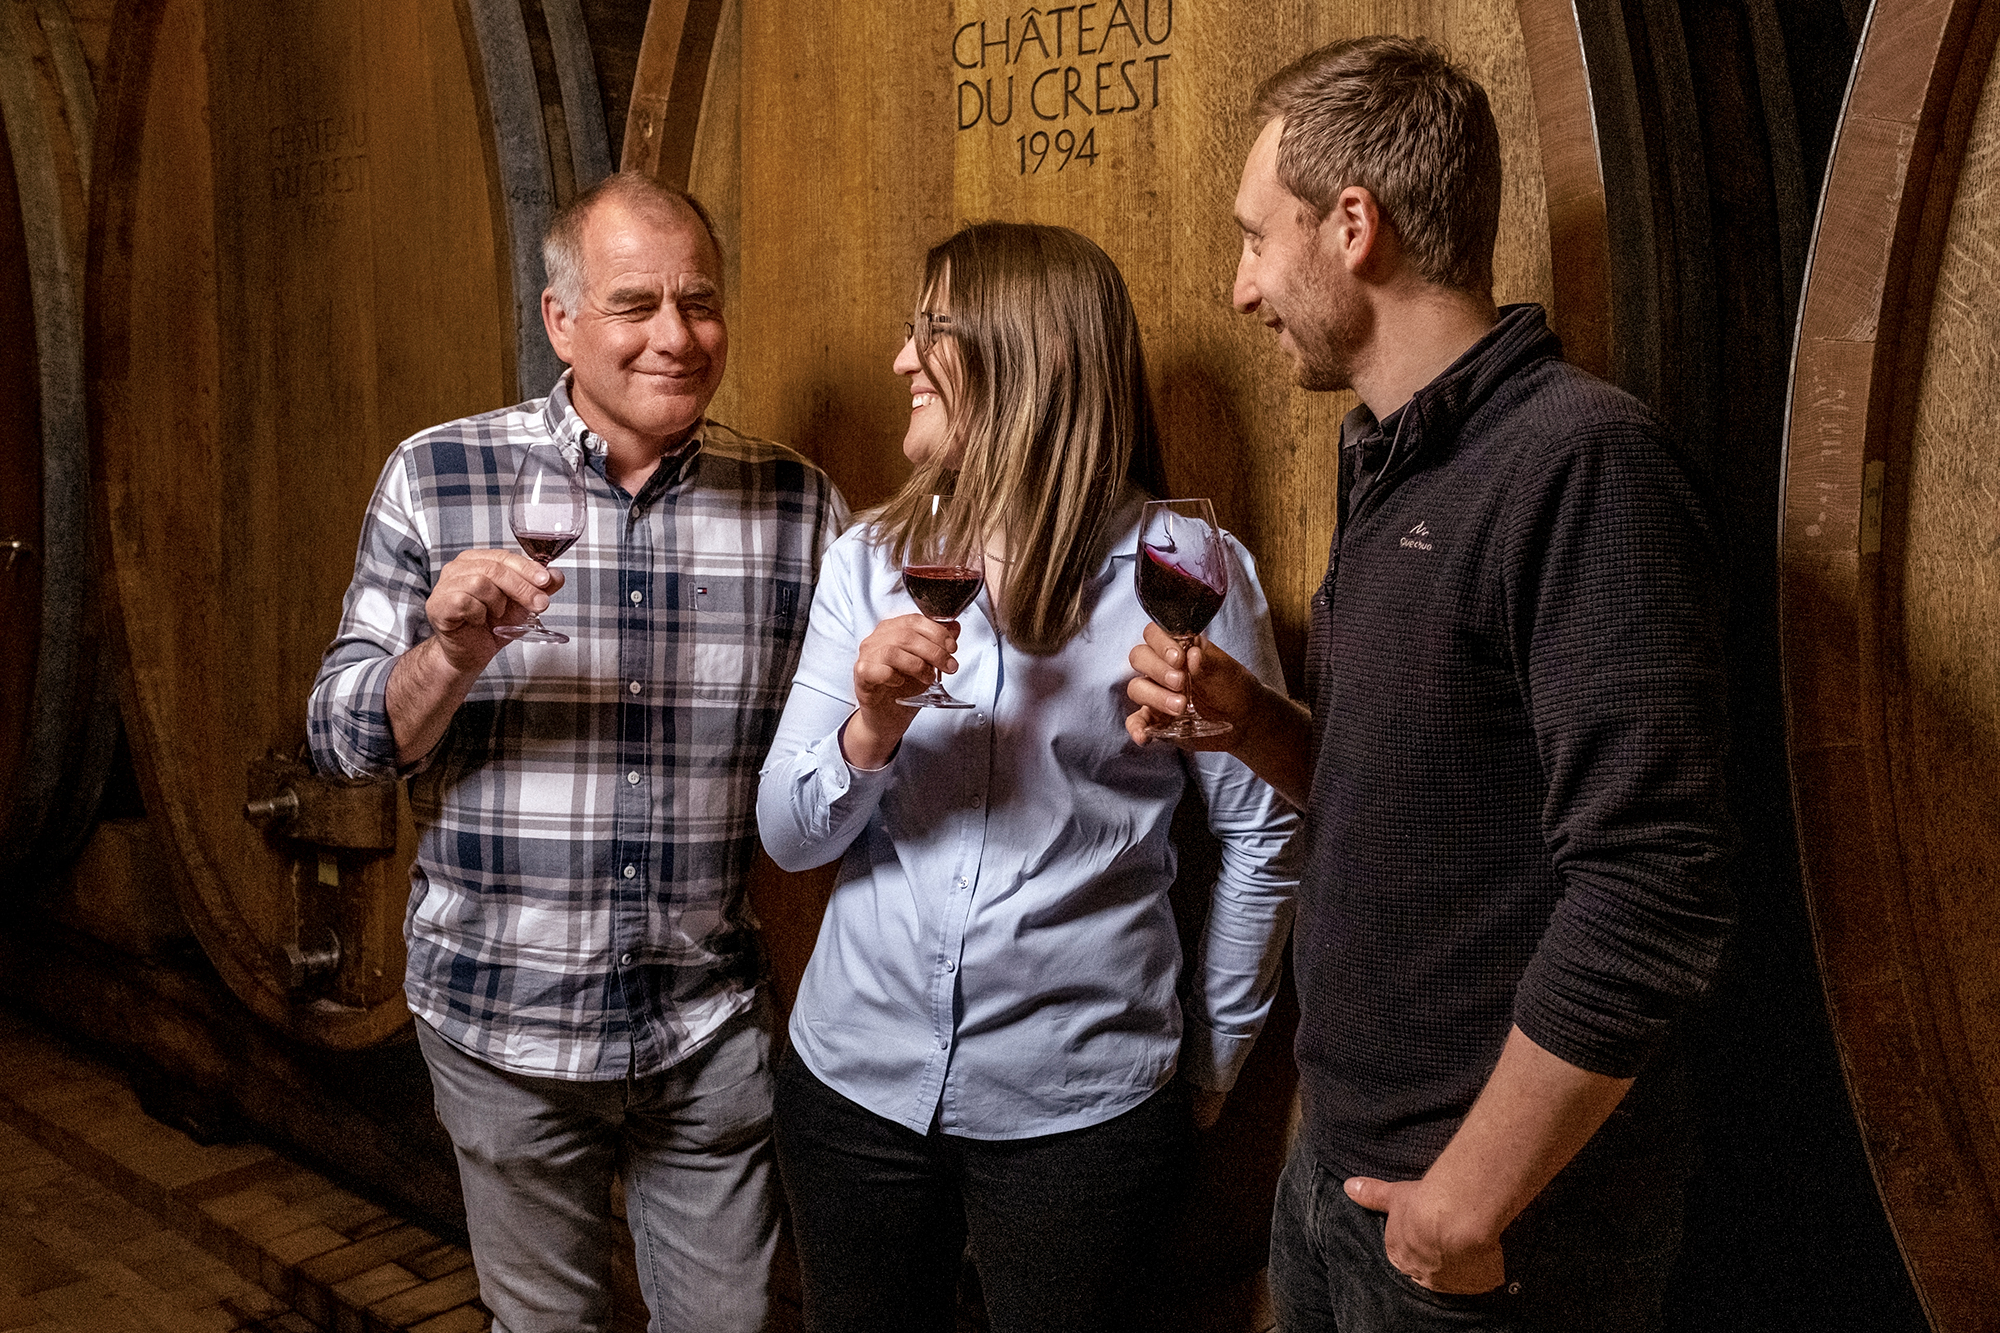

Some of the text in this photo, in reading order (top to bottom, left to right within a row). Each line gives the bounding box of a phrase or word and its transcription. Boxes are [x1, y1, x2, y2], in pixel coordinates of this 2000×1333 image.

[952, 0, 1173, 70] CHÂTEAU
[957, 53, 1172, 131] DU CREST
[1016, 126, 1100, 176] 1994
